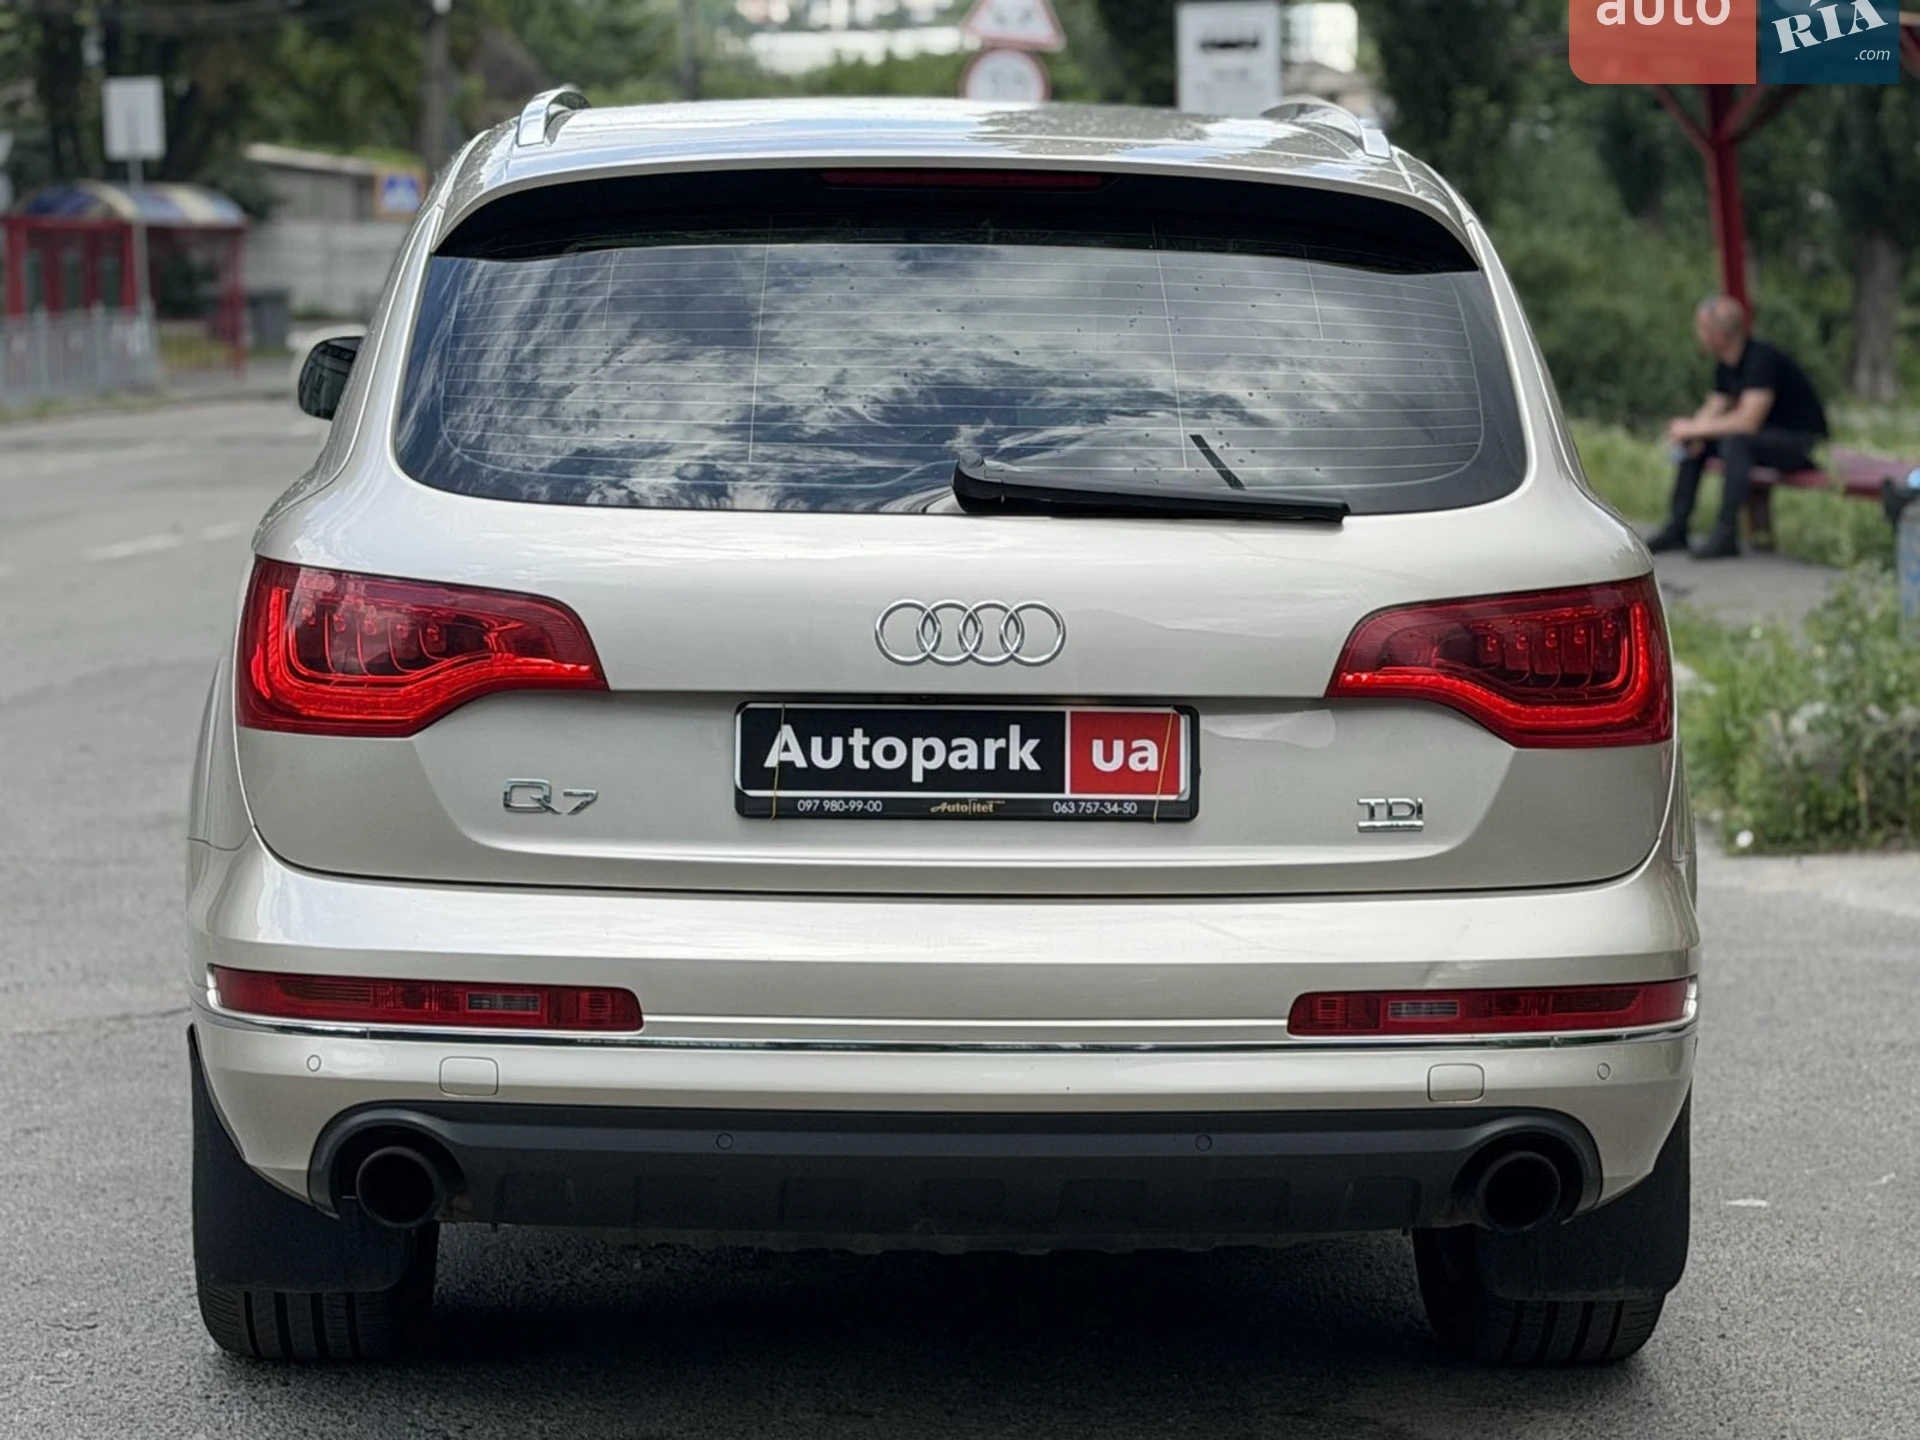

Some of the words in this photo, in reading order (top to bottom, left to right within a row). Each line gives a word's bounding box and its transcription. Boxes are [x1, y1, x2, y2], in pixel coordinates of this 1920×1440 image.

[764, 724, 1041, 782] Autopark
[1092, 739, 1160, 772] ua
[503, 778, 598, 815] Q7
[797, 800, 820, 812] 097
[822, 800, 883, 812] 980-99-00
[1052, 801, 1076, 814] 063
[1078, 802, 1138, 815] 757-34-50
[1357, 797, 1423, 821] TDI
